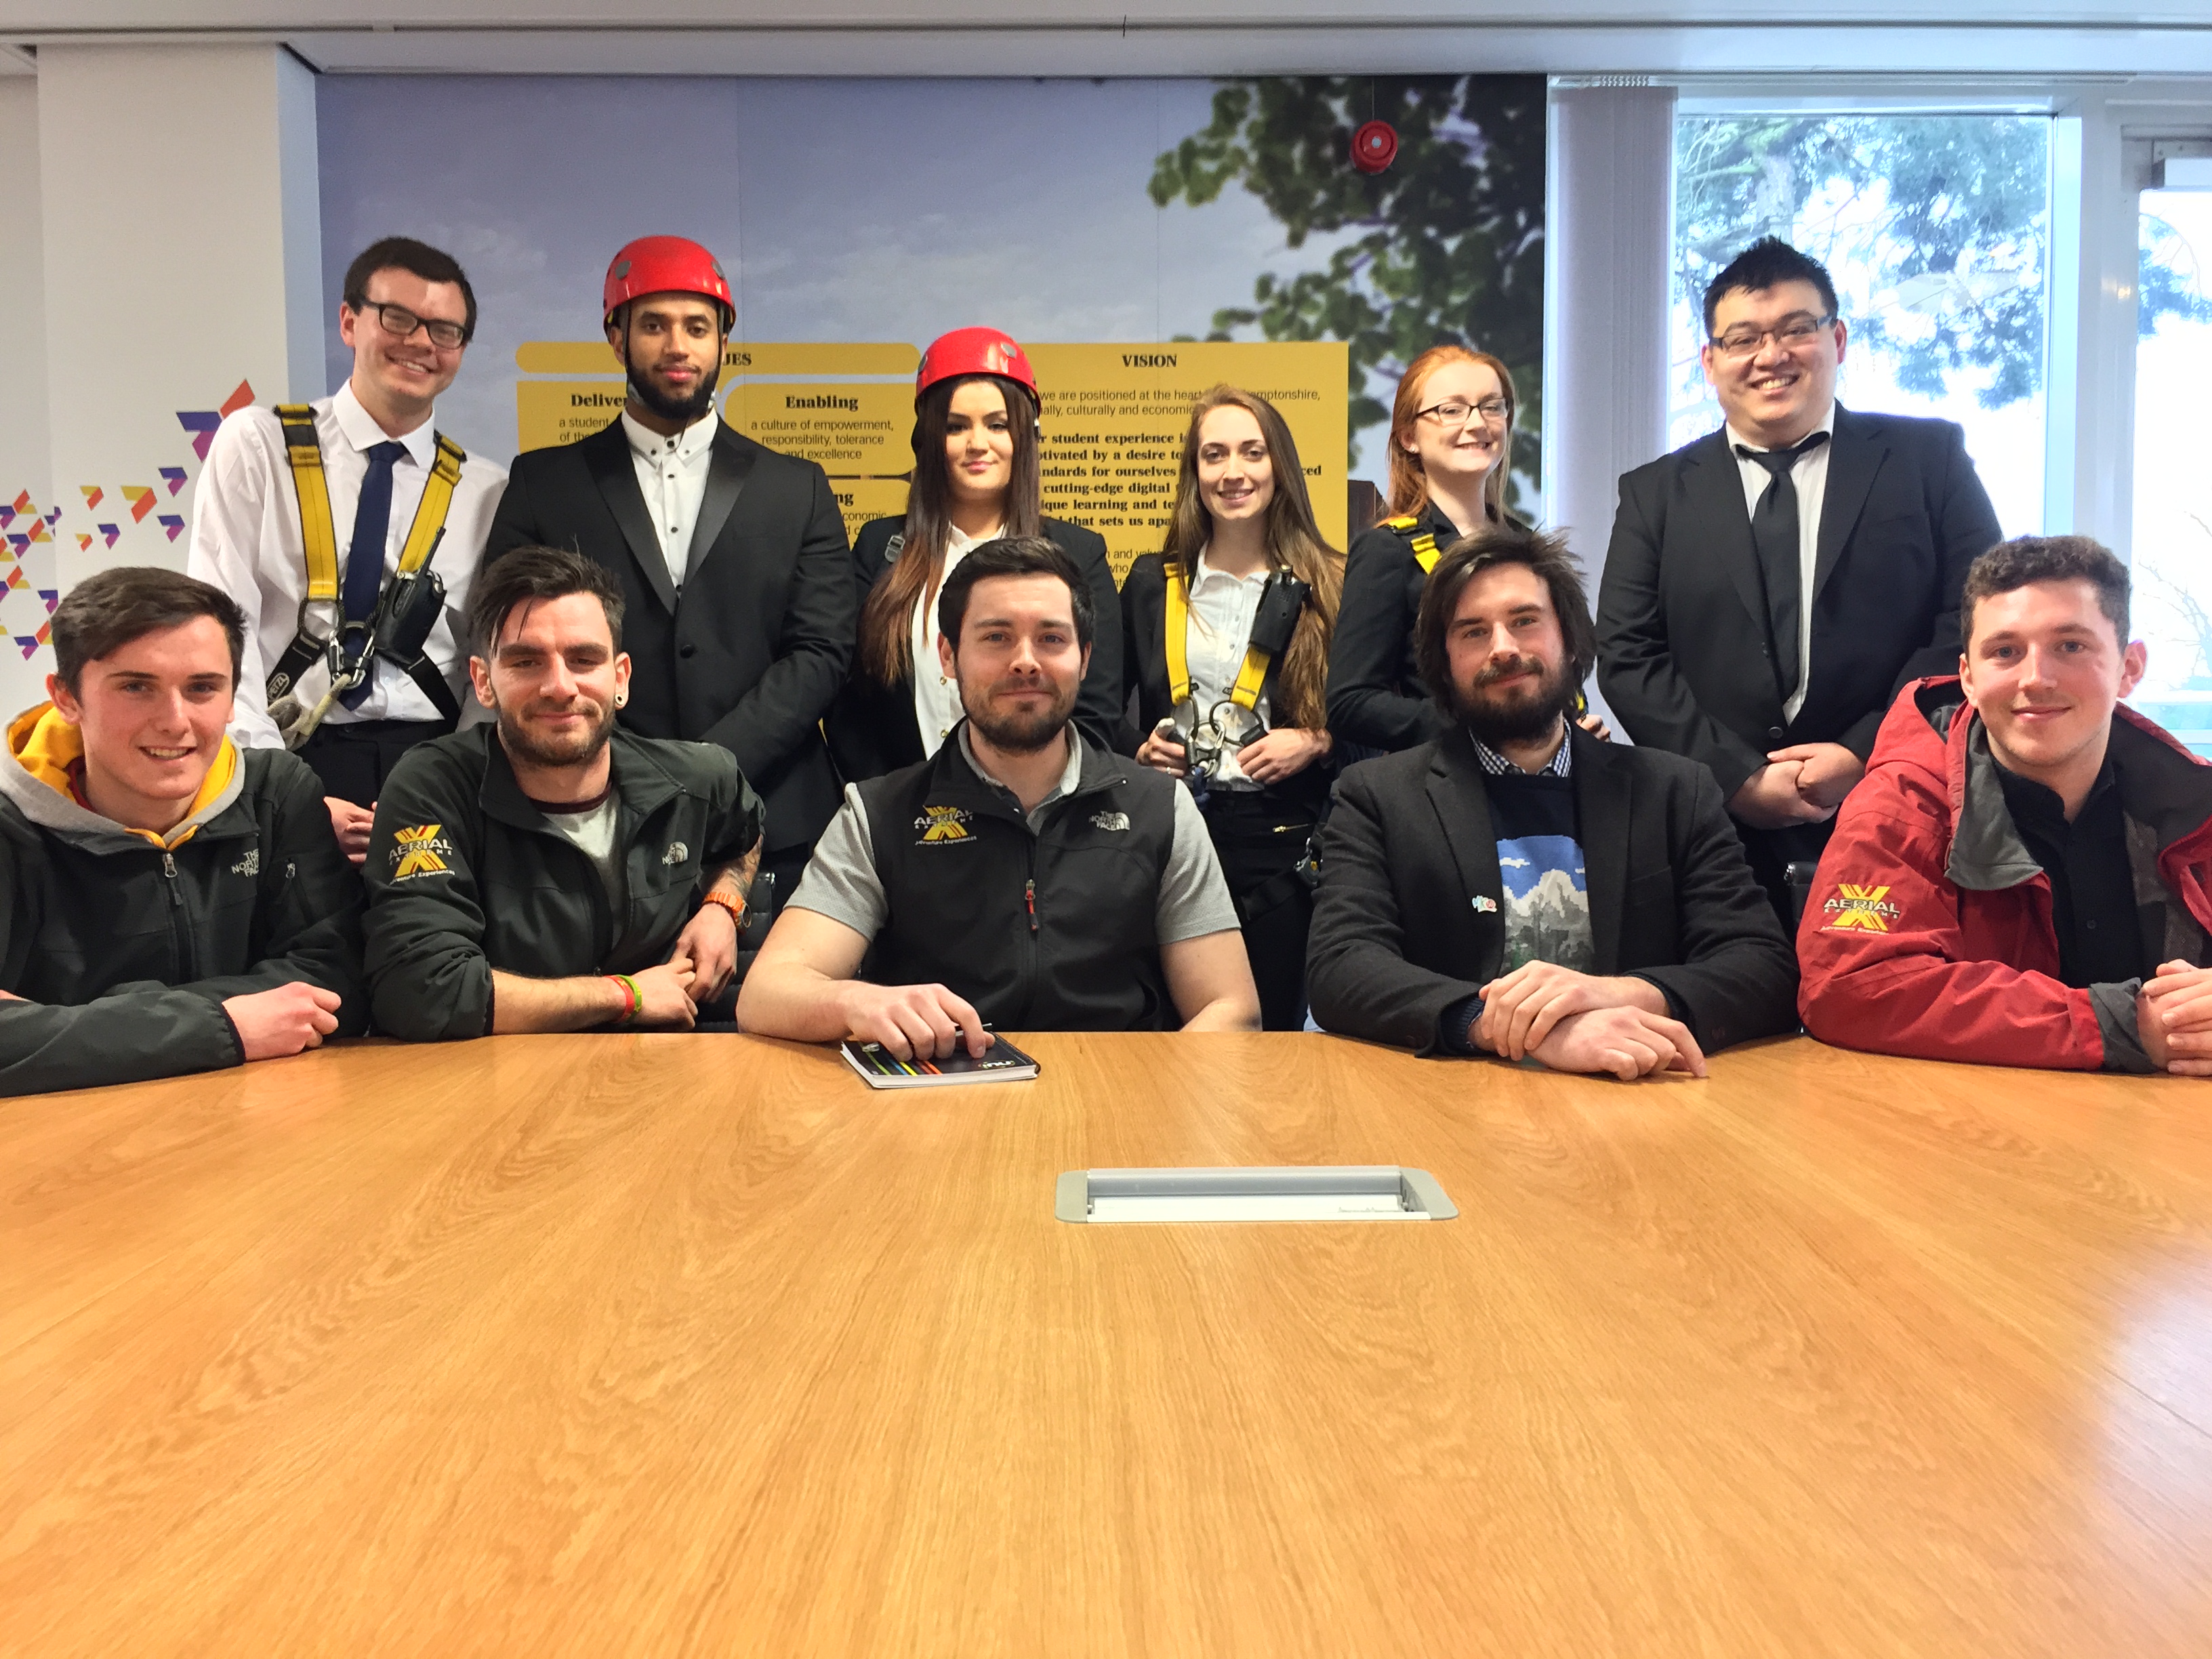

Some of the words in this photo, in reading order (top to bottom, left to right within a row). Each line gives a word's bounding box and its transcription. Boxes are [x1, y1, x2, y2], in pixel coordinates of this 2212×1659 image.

[1122, 354, 1177, 367] VISION
[571, 394, 627, 407] Deliver
[1040, 391, 1056, 401] we
[1059, 391, 1076, 401] are
[1080, 389, 1136, 402] positioned
[1139, 390, 1149, 401] at
[1153, 389, 1170, 401] the
[1256, 388, 1320, 401] mptonshire,
[785, 396, 859, 411] Enabling
[1067, 404, 1115, 417] culturally
[1119, 405, 1139, 415] and
[1142, 404, 1193, 415] economic
[559, 419, 566, 428] a
[569, 417, 609, 428] student
[751, 421, 758, 430] a
[760, 419, 797, 430] culture
[800, 419, 811, 430] of
[813, 419, 894, 434] empowerment,
[560, 432, 571, 442] of
[762, 434, 832, 447] responsibility,
[836, 434, 884, 445] tolerance
[1052, 433, 1100, 444] student
[1105, 432, 1174, 446] experience
[807, 449, 862, 460] excellence
[1092, 449, 1109, 463] by
[1113, 452, 1121, 461] a
[1126, 449, 1166, 461] desire
[1040, 466, 1087, 477] ndards
[1092, 466, 1111, 477] for
[1115, 466, 1176, 477] ourselves
[1043, 483, 1124, 496] cutting-edge
[1128, 482, 1171, 496] digital
[1041, 499, 1068, 512] ique
[1073, 499, 1128, 512] learning
[1132, 499, 1158, 510] and
[842, 511, 887, 521] conomic
[1099, 516, 1124, 527] sets
[1129, 518, 1144, 527] us
[1147, 518, 1170, 529] apa
[1113, 548, 1133, 559] and
[914, 810, 973, 825] AERIAL
[388, 838, 453, 861] AERIAL
[1823, 899, 1900, 914] AERIAL
